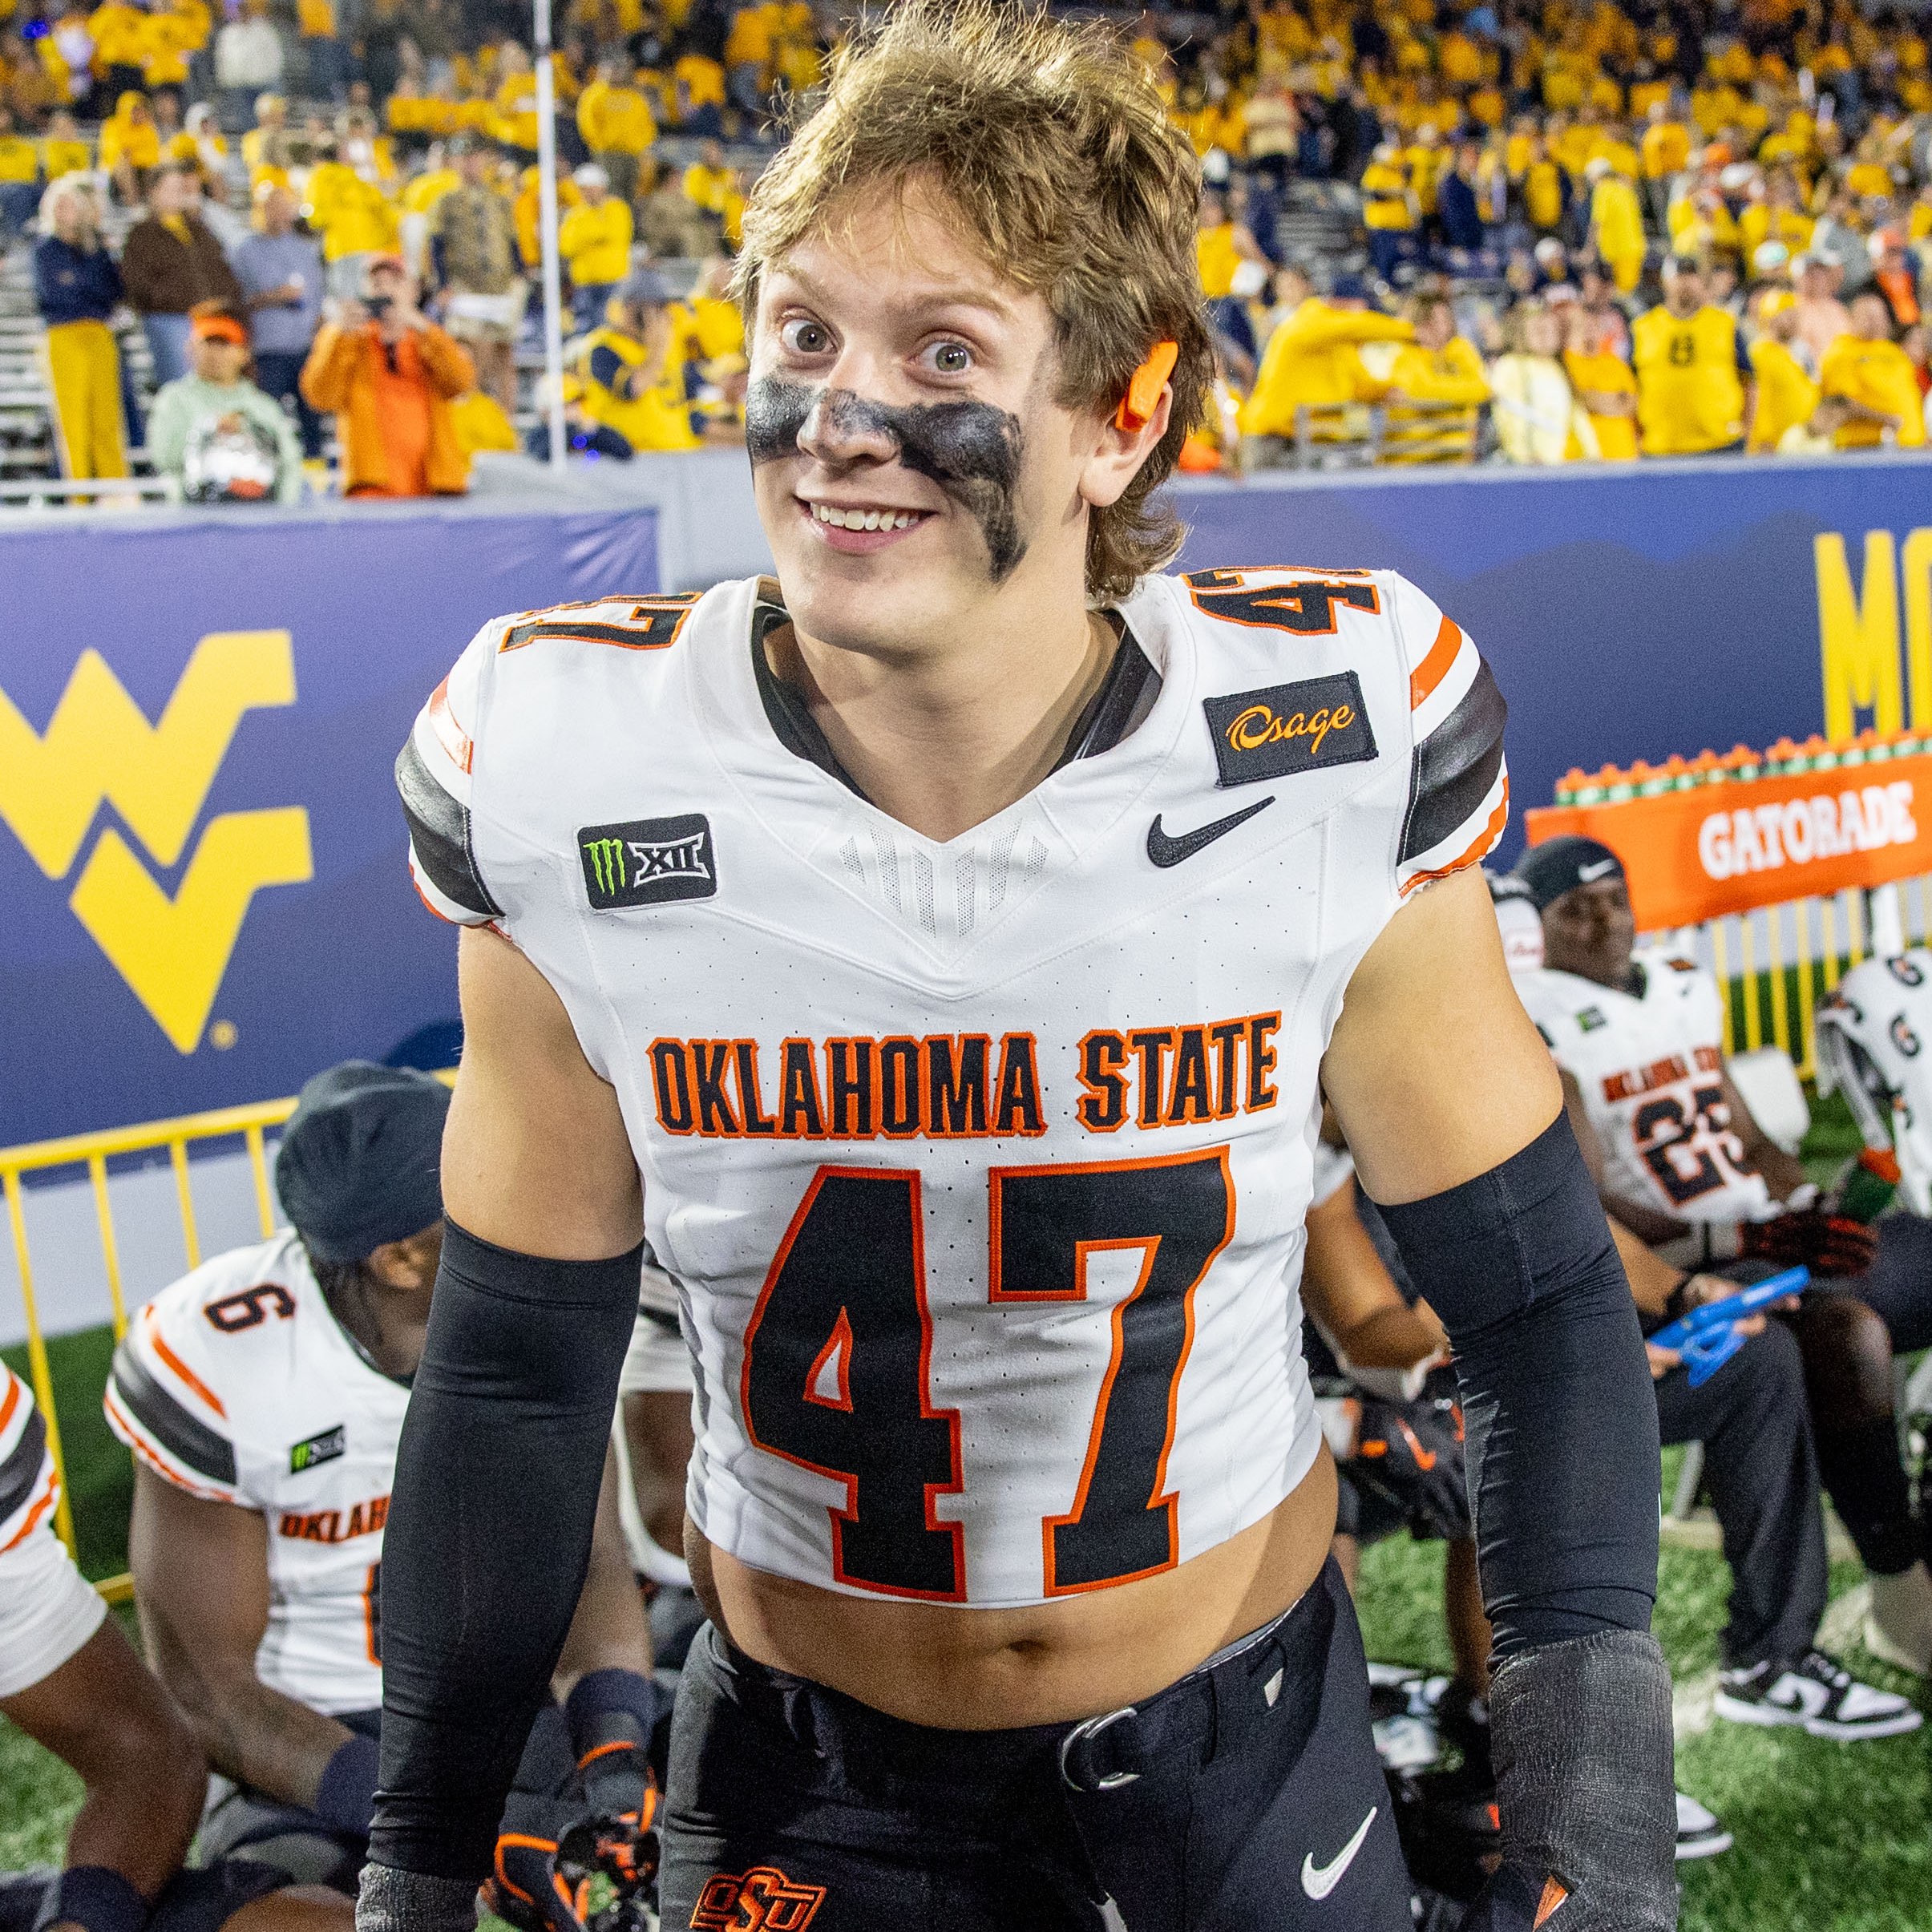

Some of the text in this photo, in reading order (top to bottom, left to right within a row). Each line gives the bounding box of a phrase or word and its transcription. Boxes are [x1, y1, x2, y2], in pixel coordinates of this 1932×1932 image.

[1225, 705, 1356, 754] Osage
[1698, 780, 1918, 879] GATORADE
[647, 1010, 1282, 1139] OKLAHOMA STATE
[741, 1144, 1237, 1603] 47
[278, 1494, 392, 1544] OKLAH
[689, 1866, 827, 1932] OSU
